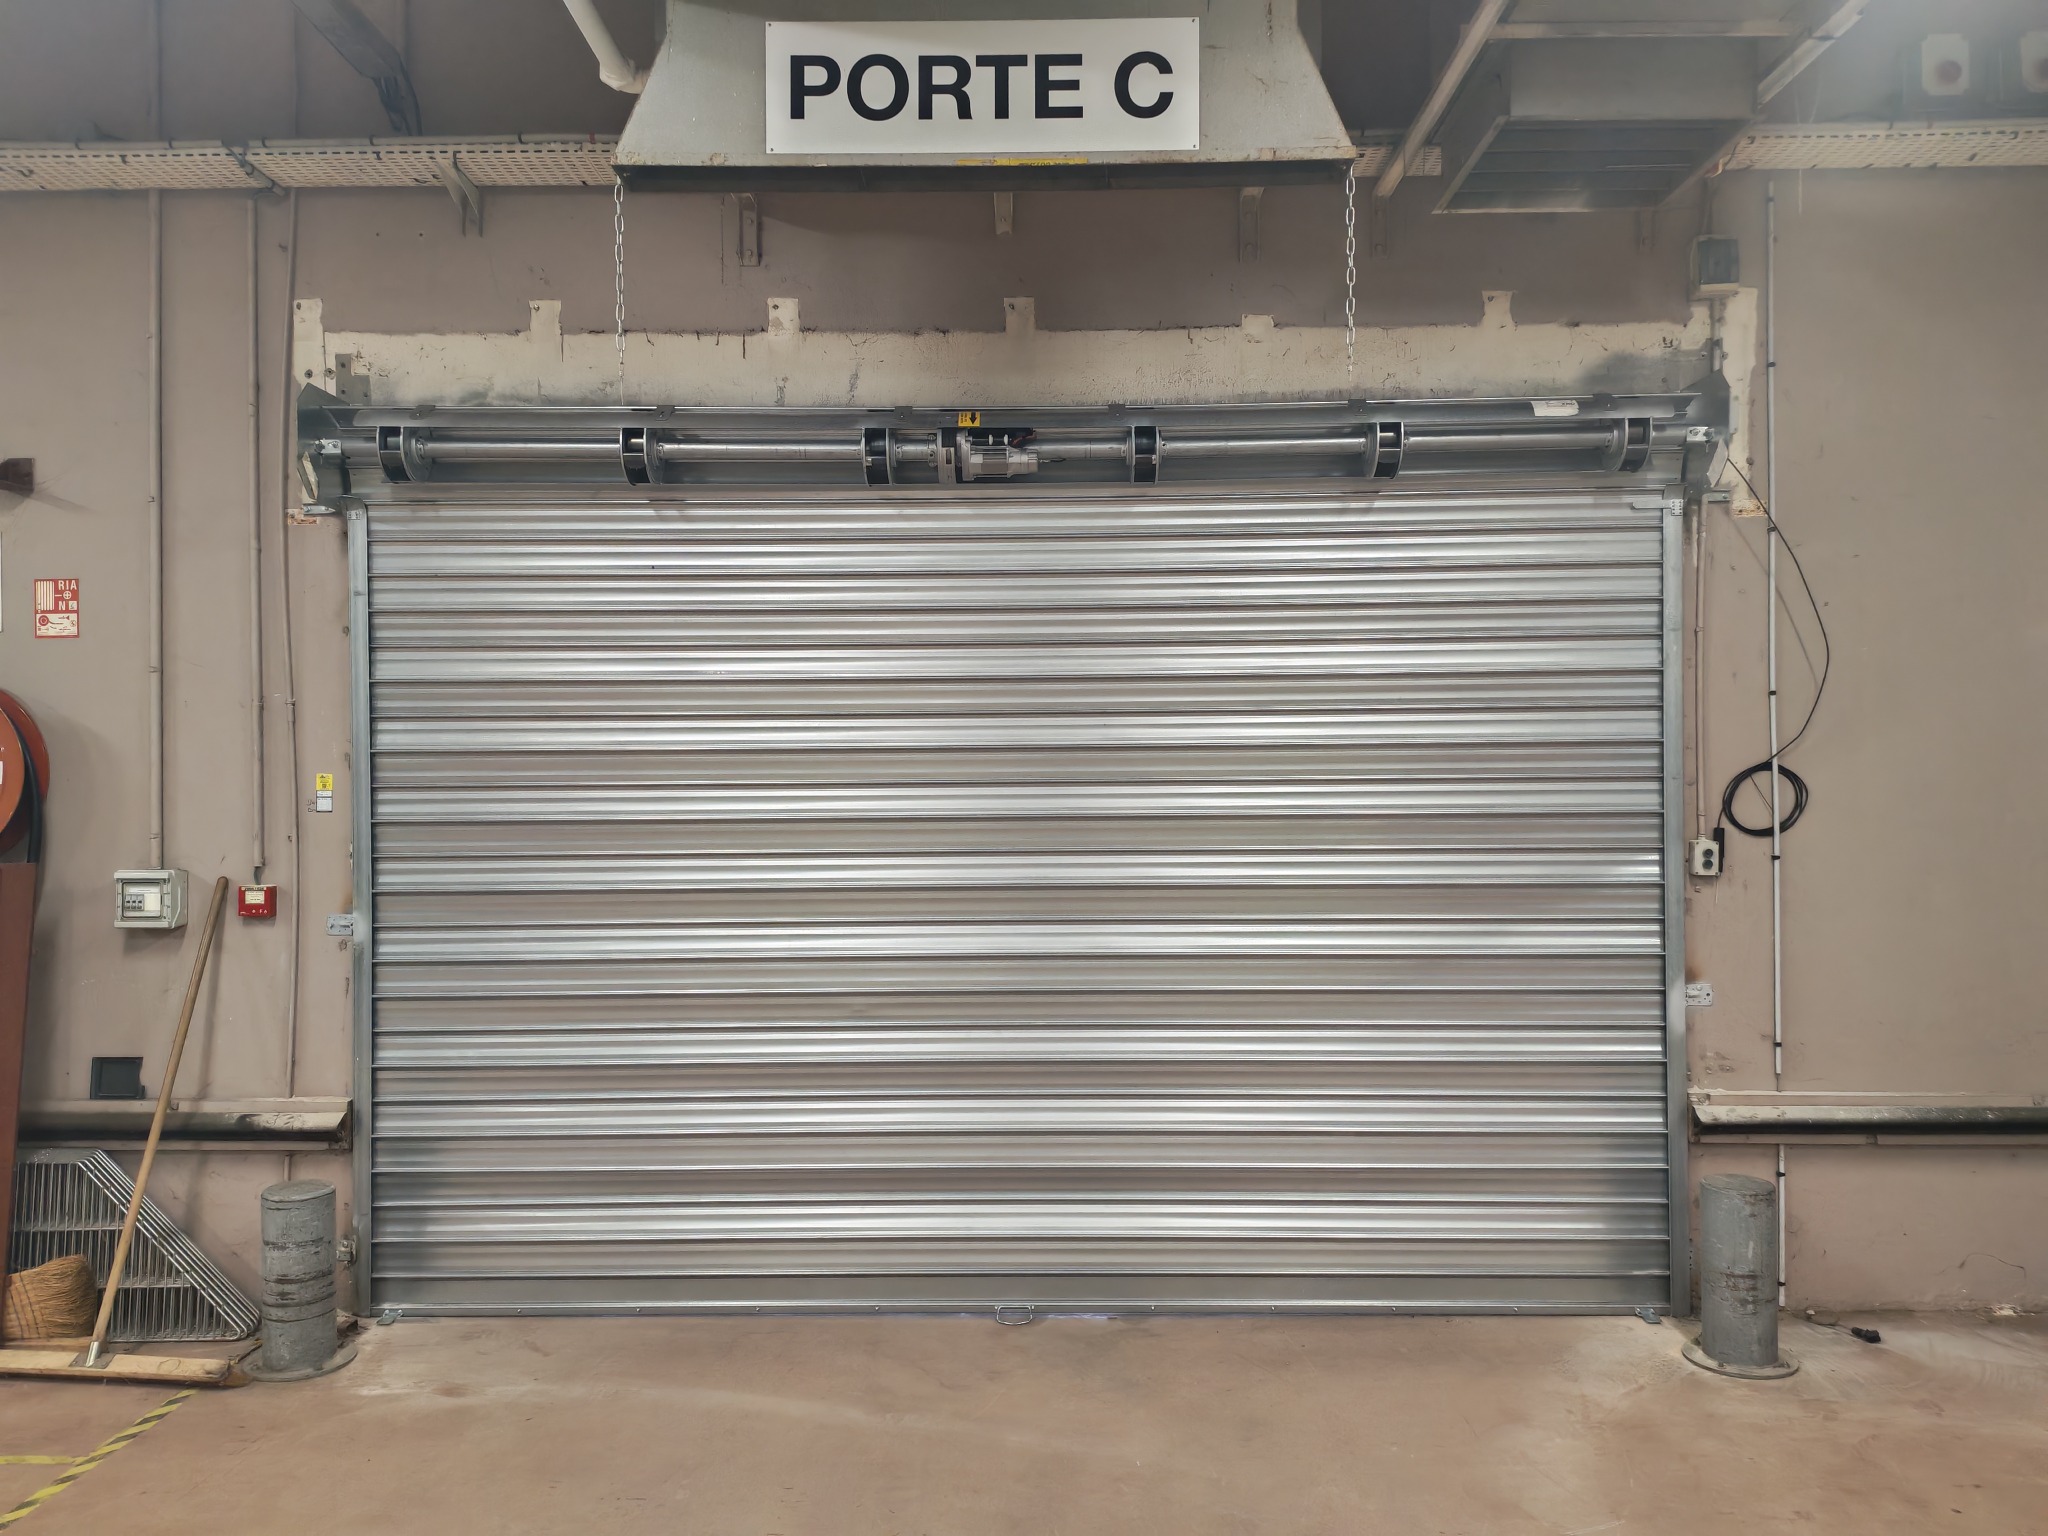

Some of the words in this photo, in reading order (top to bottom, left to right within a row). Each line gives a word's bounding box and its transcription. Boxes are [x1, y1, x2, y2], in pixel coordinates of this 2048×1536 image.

[790, 53, 1084, 121] PORTE
[1114, 51, 1174, 119] C
[58, 580, 77, 590] RIA
[58, 601, 65, 610] N
